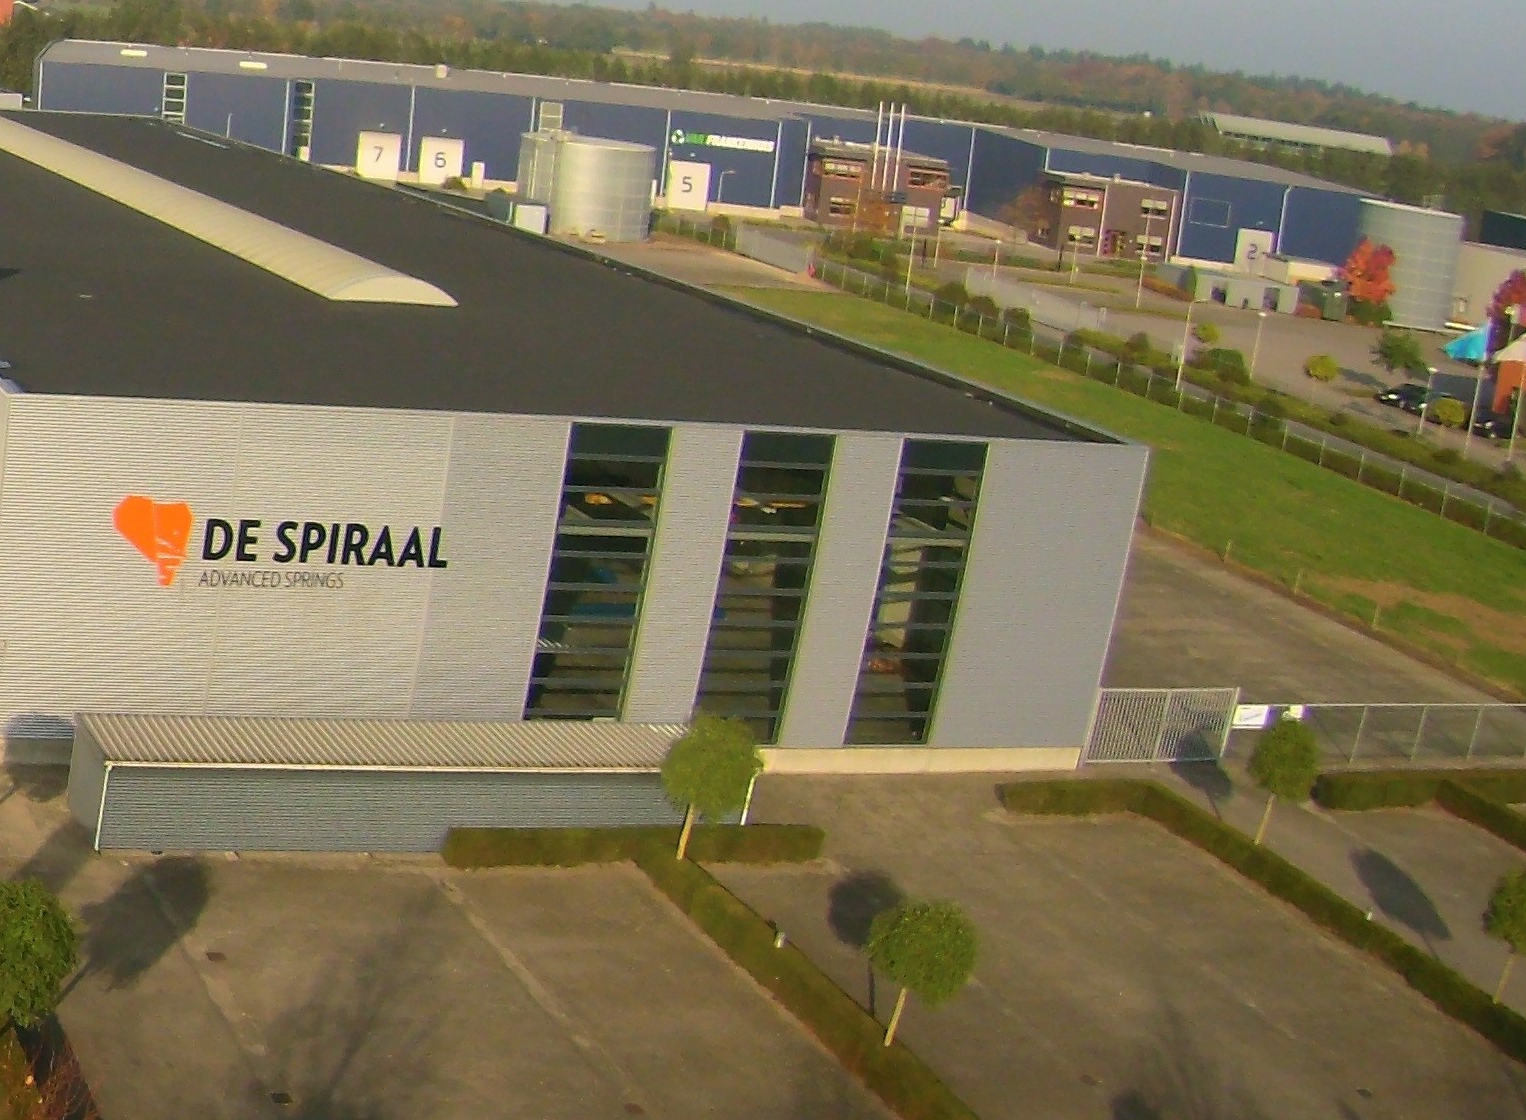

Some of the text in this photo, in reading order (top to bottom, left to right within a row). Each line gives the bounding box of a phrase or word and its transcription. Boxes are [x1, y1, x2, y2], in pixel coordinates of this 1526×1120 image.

[373, 145, 385, 163] 7
[434, 151, 447, 169] 6
[681, 175, 693, 193] 5
[1246, 243, 1258, 260] 2
[201, 518, 448, 568] DE SPIRAAL
[198, 569, 345, 589] ADVANCED SPRINGS
